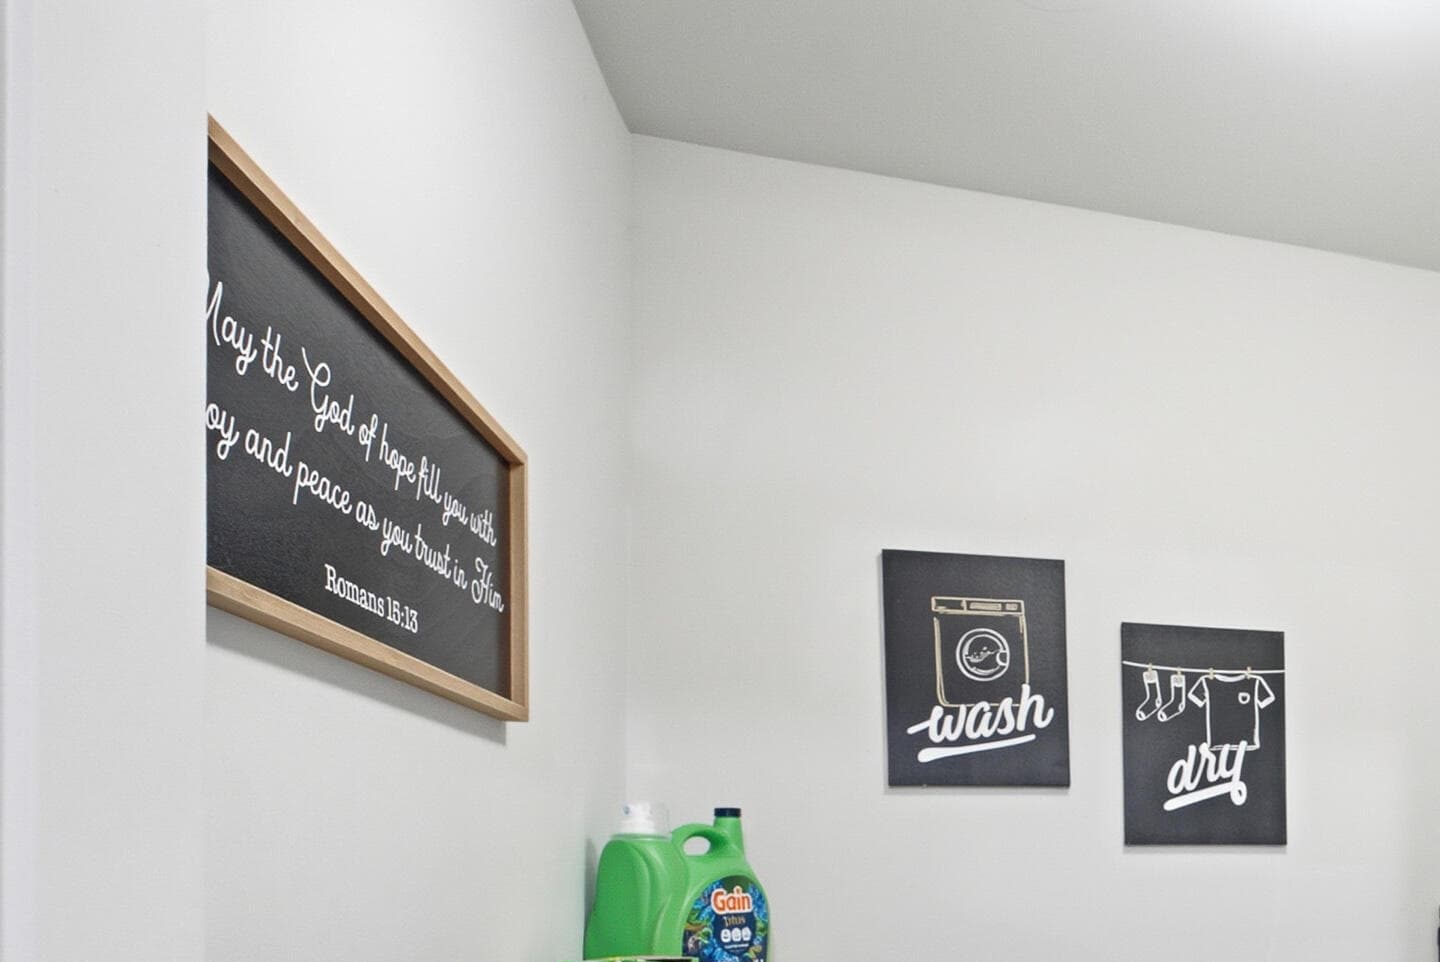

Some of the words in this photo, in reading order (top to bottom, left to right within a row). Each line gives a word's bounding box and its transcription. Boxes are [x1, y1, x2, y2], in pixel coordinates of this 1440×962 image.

[261, 326, 299, 391] the
[301, 347, 355, 435] God
[359, 413, 379, 462] of
[379, 423, 416, 490] hope
[416, 456, 443, 504] fill
[442, 492, 468, 526] you
[470, 510, 497, 546] with
[245, 429, 293, 477] and
[293, 461, 352, 514] peace
[356, 500, 380, 531] as
[381, 518, 413, 556] you
[415, 524, 451, 579] trust
[453, 559, 468, 589] in
[471, 557, 504, 613] Him
[324, 563, 385, 617] Romans
[386, 596, 419, 633] 15:13
[907, 683, 1054, 743] wash
[1167, 741, 1249, 805] dry
[711, 886, 753, 914] Gain
